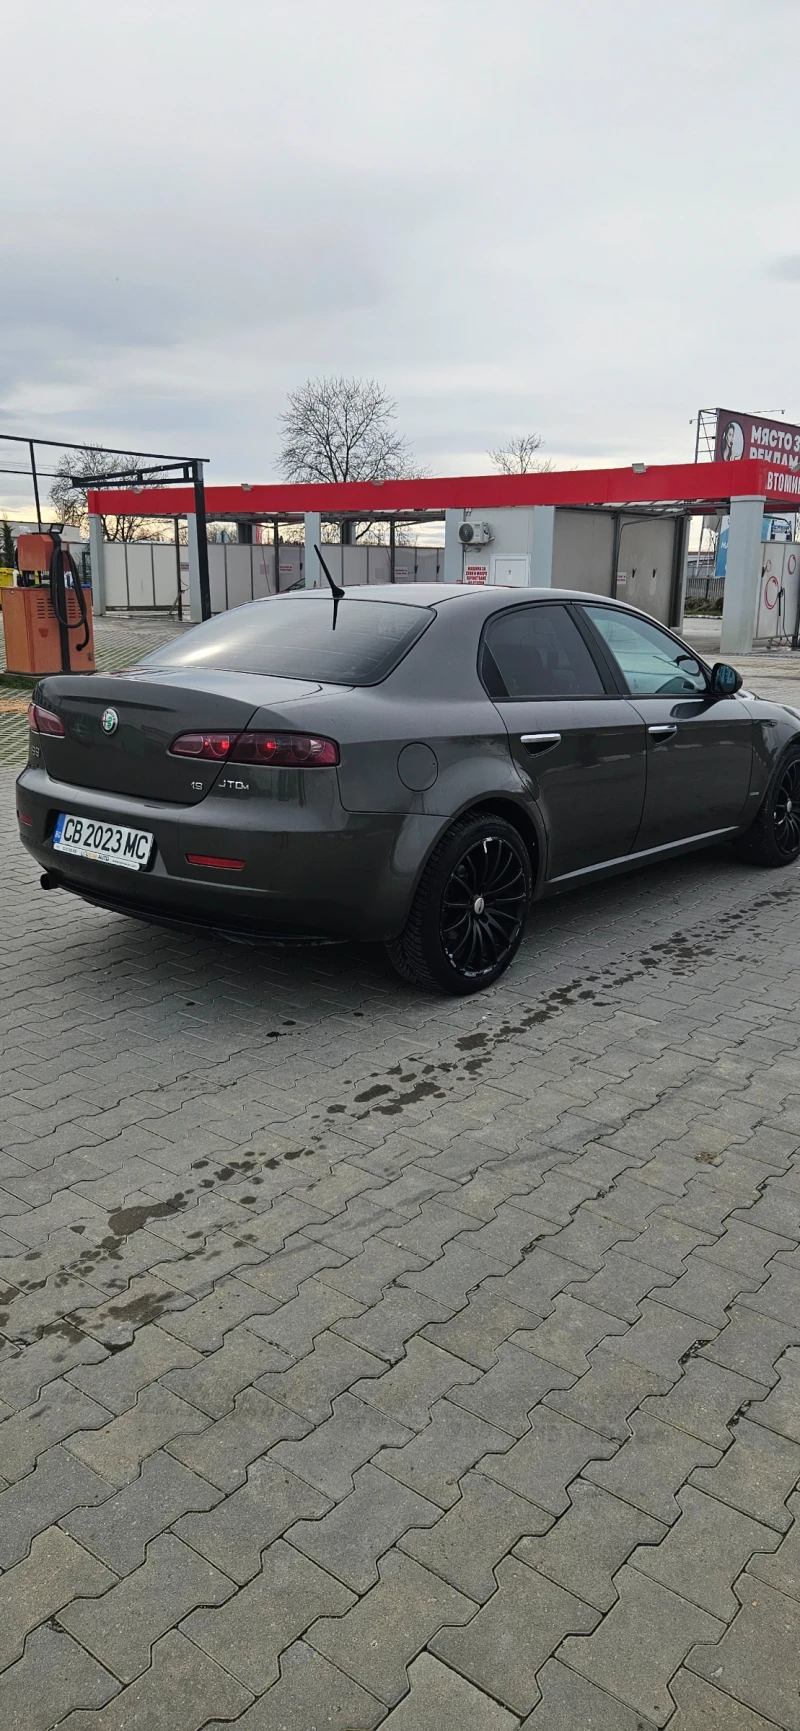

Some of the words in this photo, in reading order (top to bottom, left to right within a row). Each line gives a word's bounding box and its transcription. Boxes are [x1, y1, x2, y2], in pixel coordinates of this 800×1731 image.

[751, 425, 792, 450] МЯСТО
[794, 435, 800, 452] З
[765, 472, 800, 494] ВТОМИ
[83, 824, 122, 853] 2023
